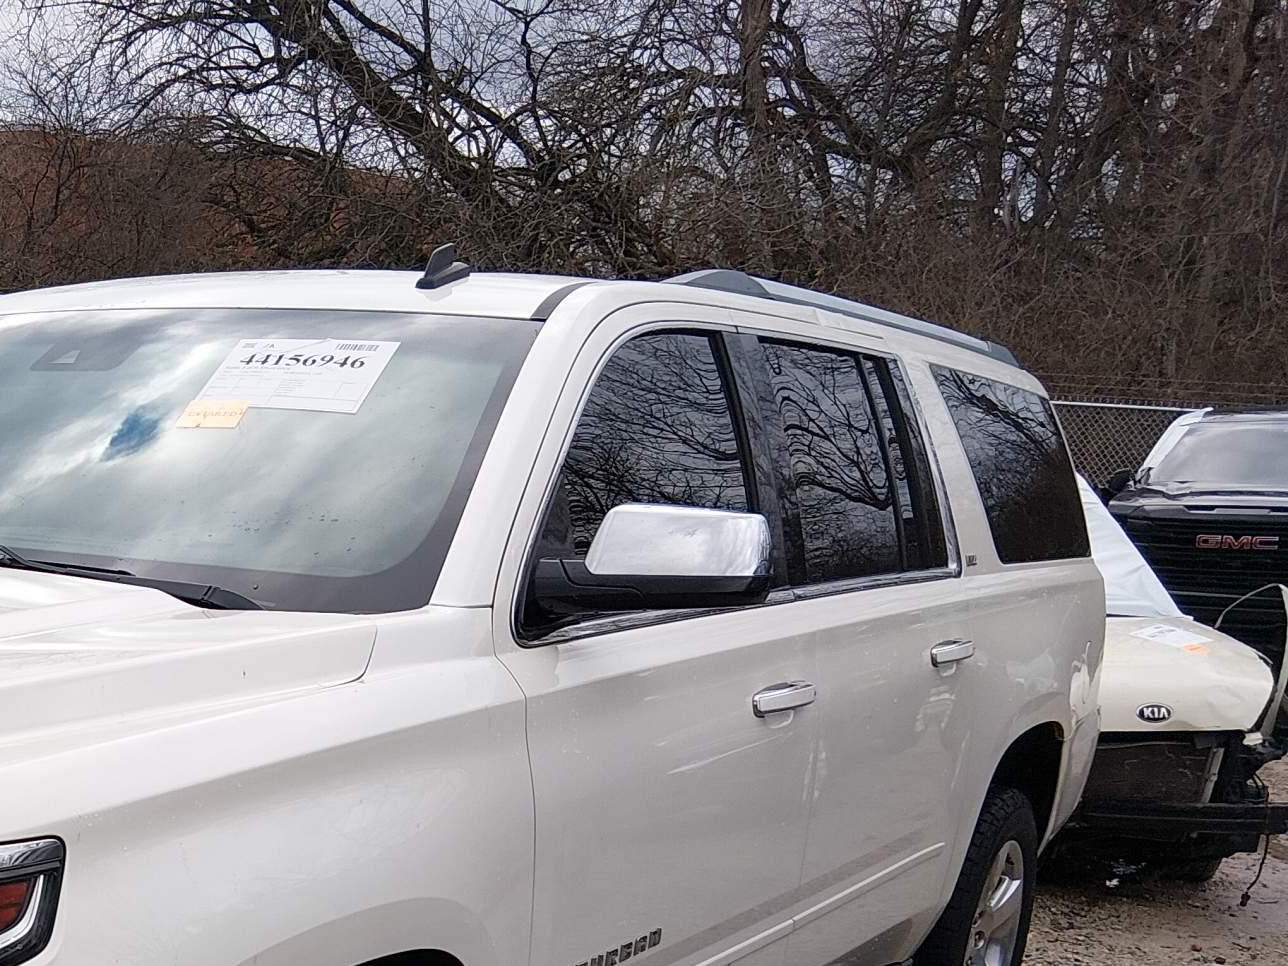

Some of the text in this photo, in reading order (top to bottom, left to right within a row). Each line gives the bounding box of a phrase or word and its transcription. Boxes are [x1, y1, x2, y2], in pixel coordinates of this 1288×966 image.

[240, 353, 365, 369] 44156946
[1196, 535, 1279, 550] GMC
[1143, 706, 1169, 718] KIA
